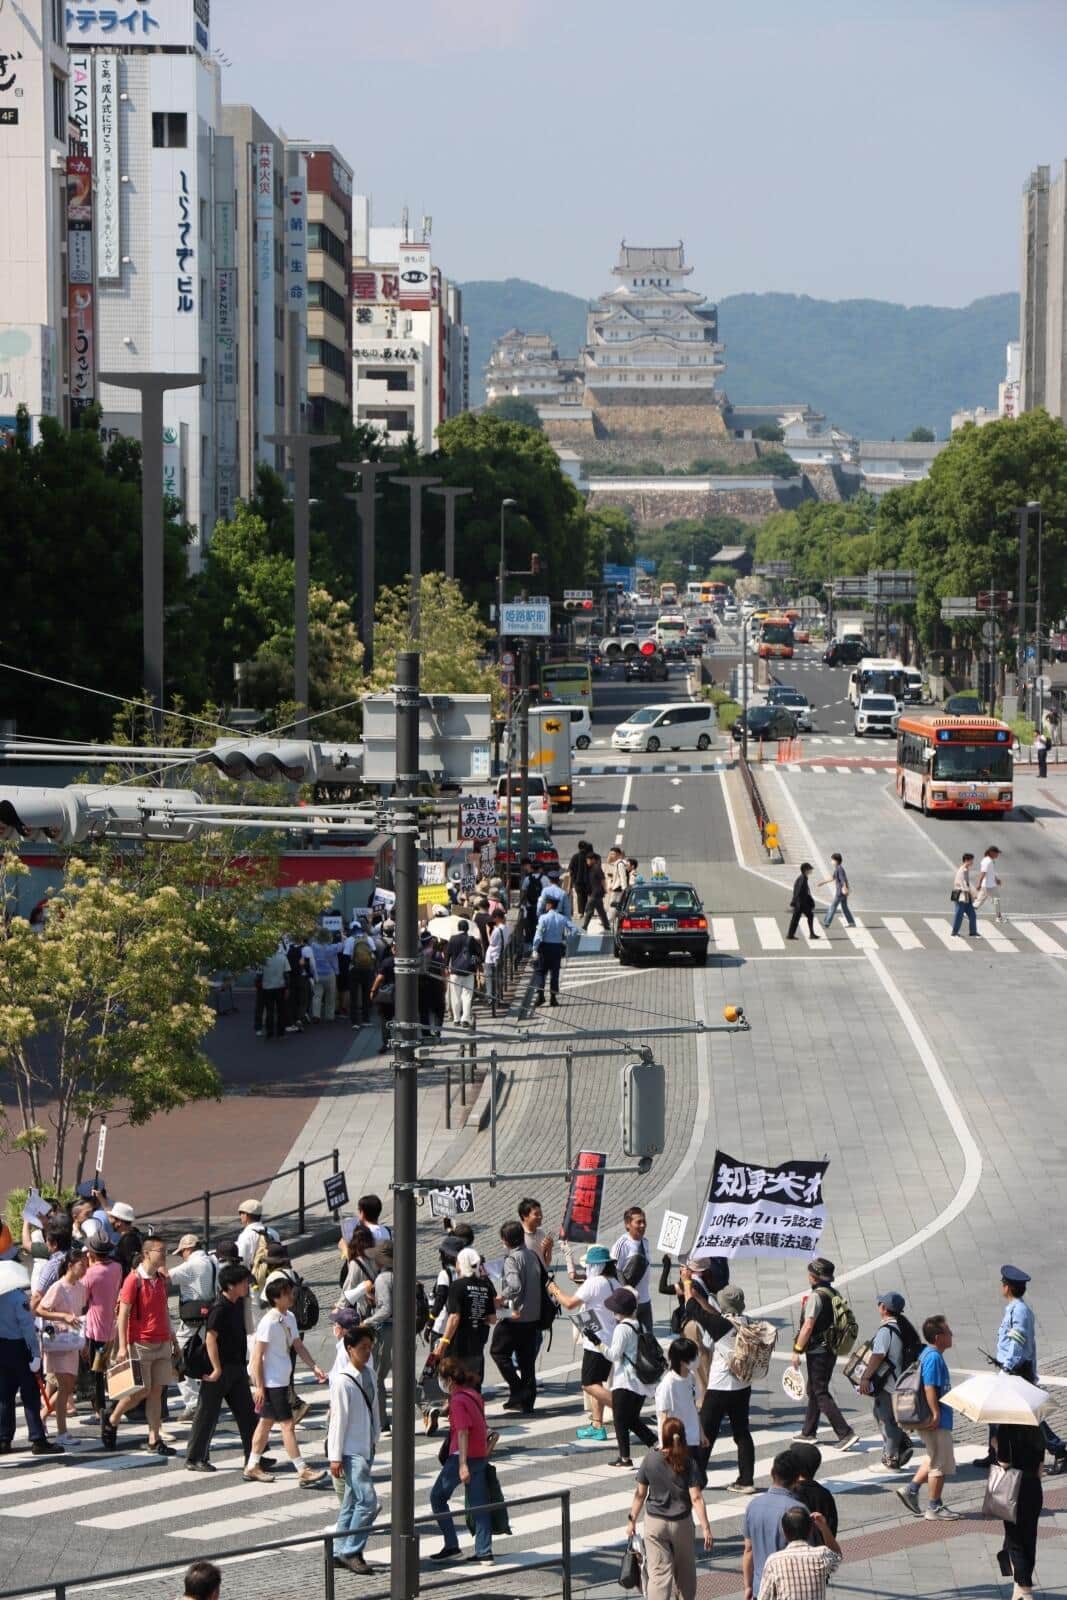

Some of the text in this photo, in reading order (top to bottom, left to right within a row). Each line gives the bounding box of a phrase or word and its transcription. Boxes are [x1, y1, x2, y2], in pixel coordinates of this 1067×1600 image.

[290, 217, 303, 299] 第一生命
[505, 610, 545, 622] 姫路駅前
[465, 812, 497, 825] あきら
[464, 826, 498, 838] めない
